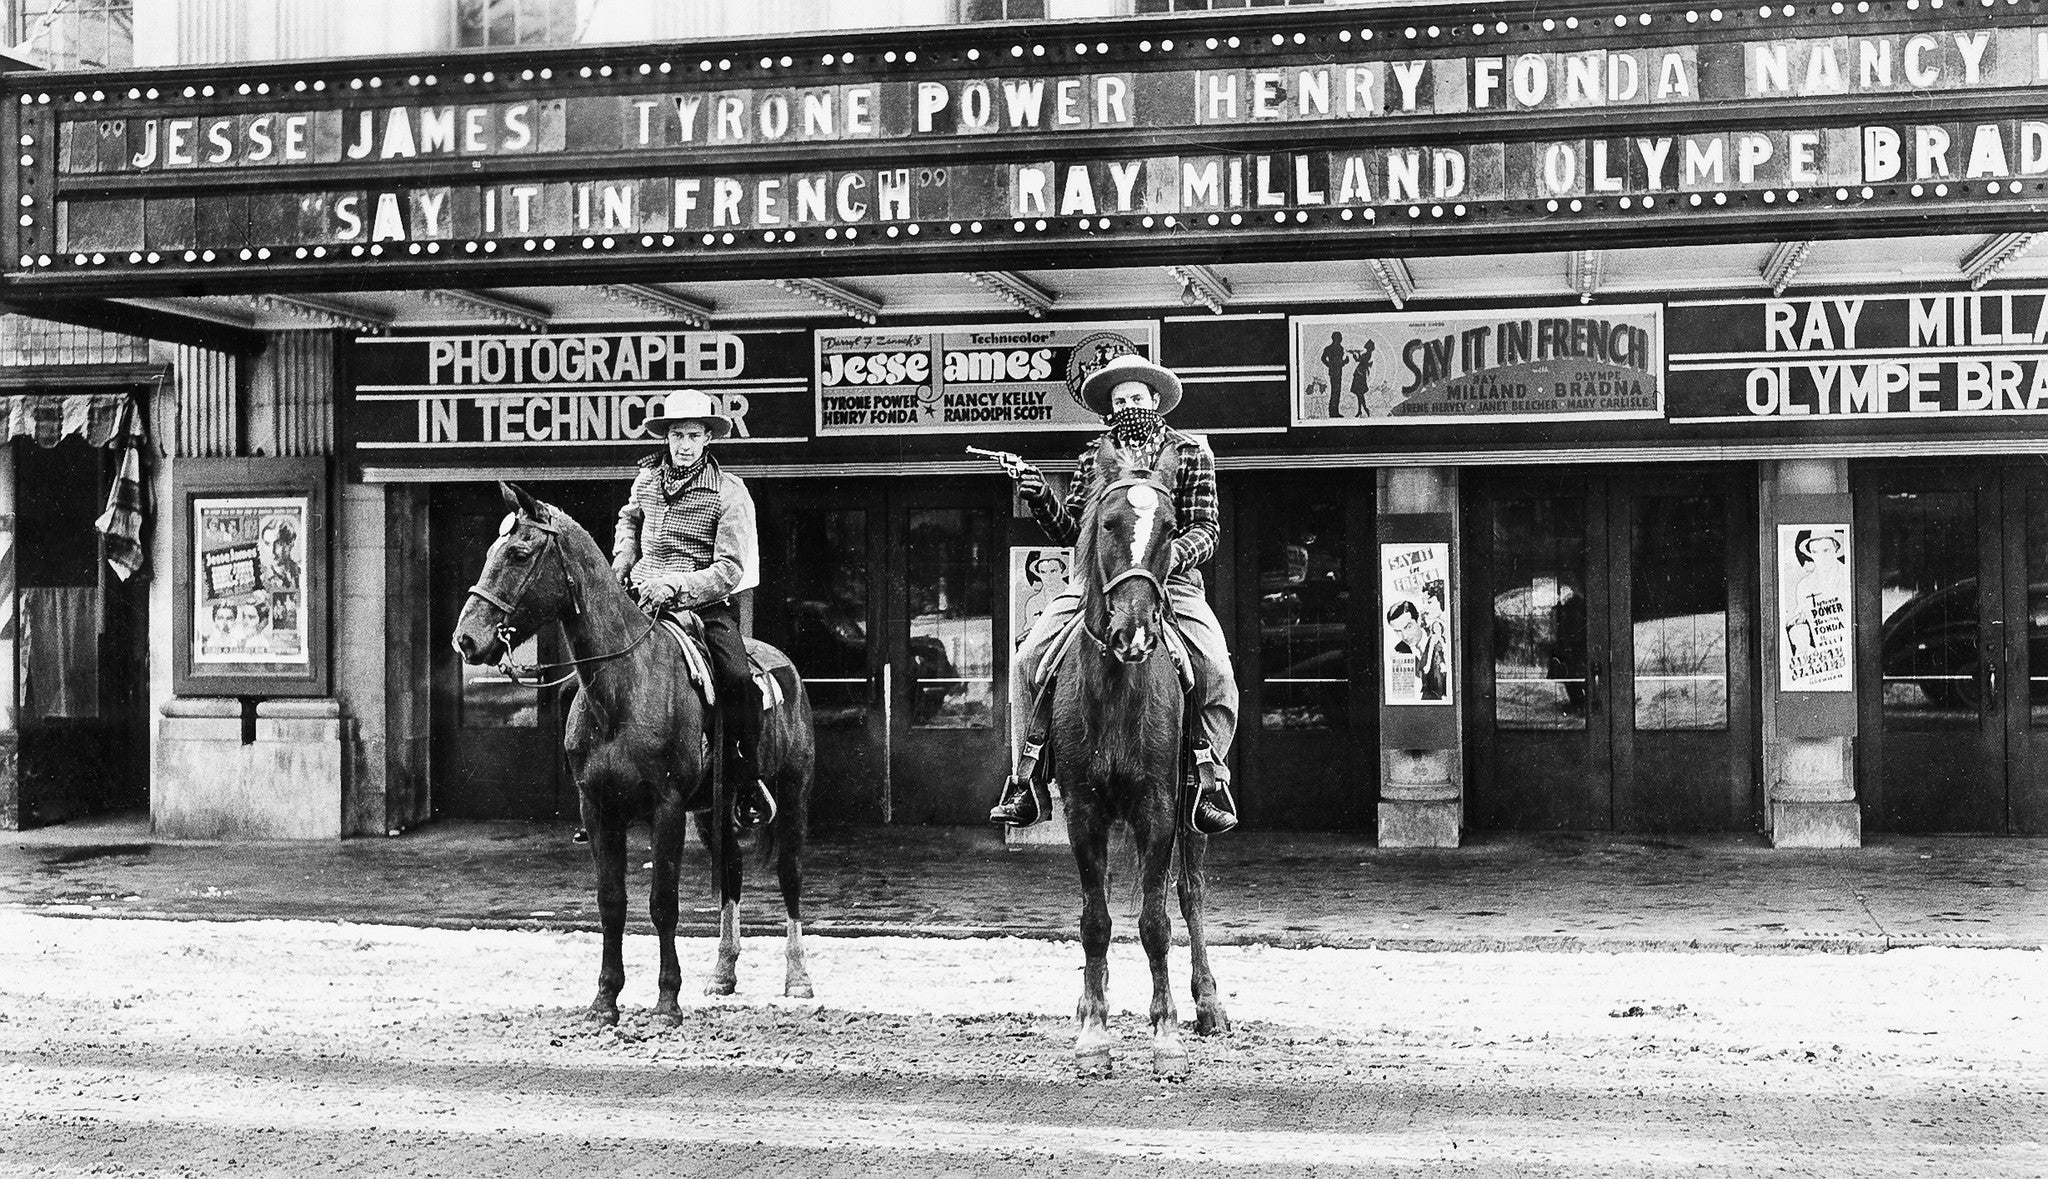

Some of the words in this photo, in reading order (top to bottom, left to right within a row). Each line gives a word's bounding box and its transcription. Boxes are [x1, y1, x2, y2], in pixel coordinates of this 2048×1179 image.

[635, 88, 872, 145] TYRONE
[917, 77, 1128, 133] POWER
[1208, 61, 1426, 119] HENRY
[1474, 53, 1690, 108] FONDA
[1754, 31, 1990, 94] NANCY
[486, 188, 538, 233] IT
[578, 186, 632, 230] IN
[1017, 160, 1142, 216] RAY
[1183, 148, 1466, 207] MILLAND
[1545, 132, 1820, 194] OLYMPE
[1864, 121, 2048, 182] BRAD
[1765, 299, 1864, 351] RAY
[429, 333, 745, 384] PHOTOGRAPHED
[1402, 334, 1455, 397] SAY
[1462, 325, 1491, 373] IT
[1497, 320, 1532, 366] IN
[1537, 318, 1648, 370] FRENCH
[1575, 371, 1621, 381] OLYMPE
[1447, 384, 1527, 400] MILLAND
[1554, 380, 1642, 398] BRADNA
[1745, 362, 1941, 416] OLYMPE
[823, 396, 871, 410] TYRONE
[873, 395, 919, 409] POWER
[944, 393, 999, 407] NANCY
[1002, 391, 1046, 405] KELLY
[419, 398, 458, 442] IN
[823, 410, 867, 424] HENRY
[870, 409, 918, 424] FONDA
[944, 407, 1011, 422] RANDOLPH
[1014, 406, 1052, 420] SCOTT
[1811, 603, 1844, 619] POWER
